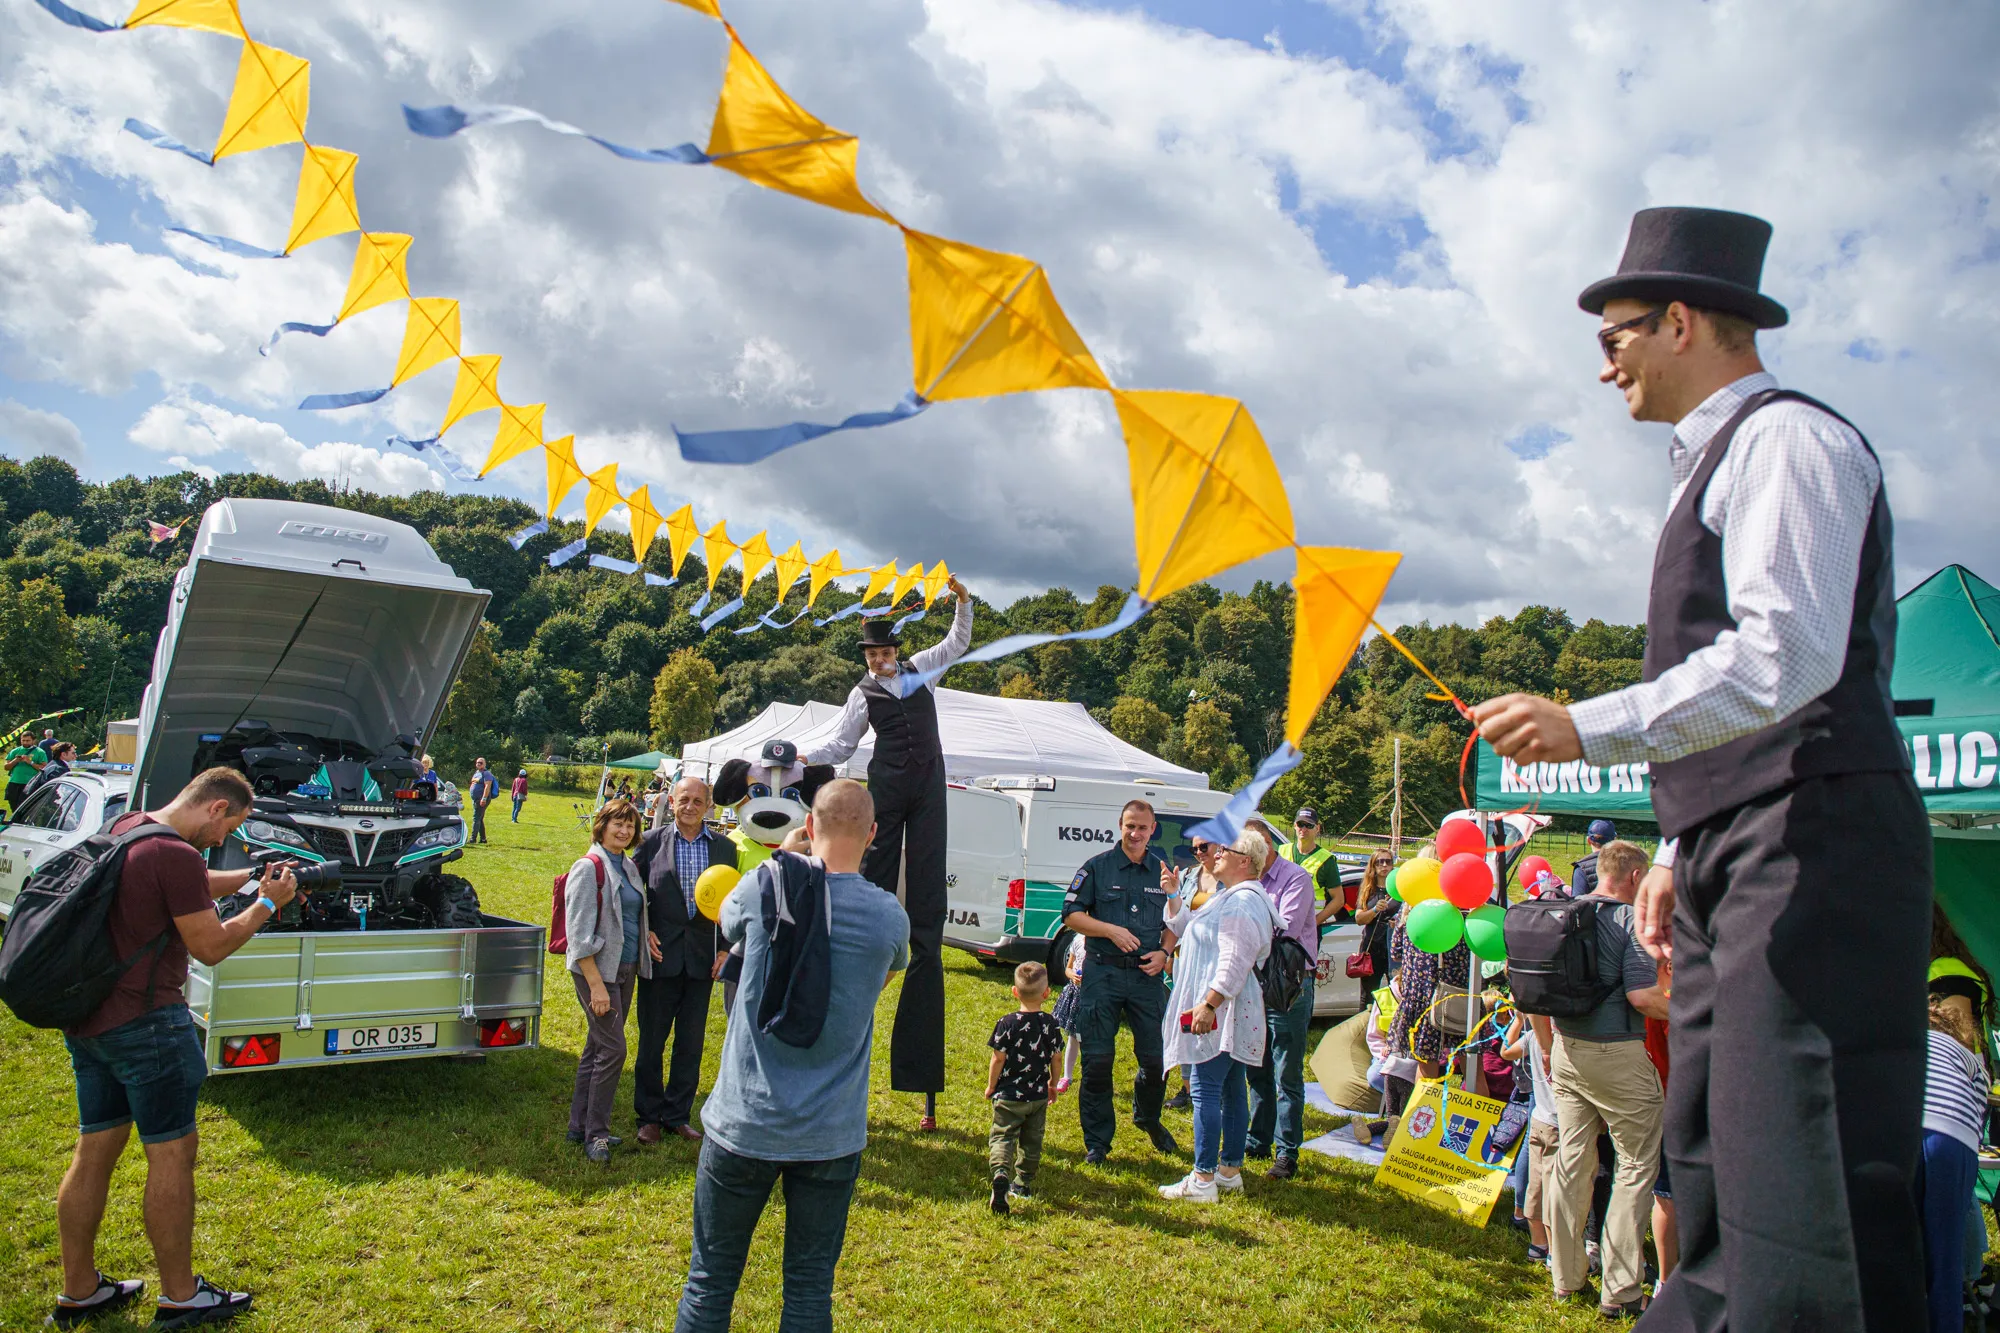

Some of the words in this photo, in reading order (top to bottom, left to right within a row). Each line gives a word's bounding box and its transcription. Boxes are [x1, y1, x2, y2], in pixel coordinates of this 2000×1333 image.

[1903, 731, 2000, 788] LIC
[1059, 827, 1114, 843] K5042
[946, 909, 980, 927] IJA
[352, 1029, 380, 1047] OR
[388, 1026, 422, 1044] 035
[1389, 1155, 1418, 1171] SAUGIOS
[1400, 1147, 1425, 1160] SAUGIA
[1426, 1154, 1455, 1172] APLINKA
[1392, 1167, 1415, 1181] KAUNO
[1414, 1176, 1454, 1196] APSKRITIES
[1456, 1190, 1487, 1208] POLICIJA
